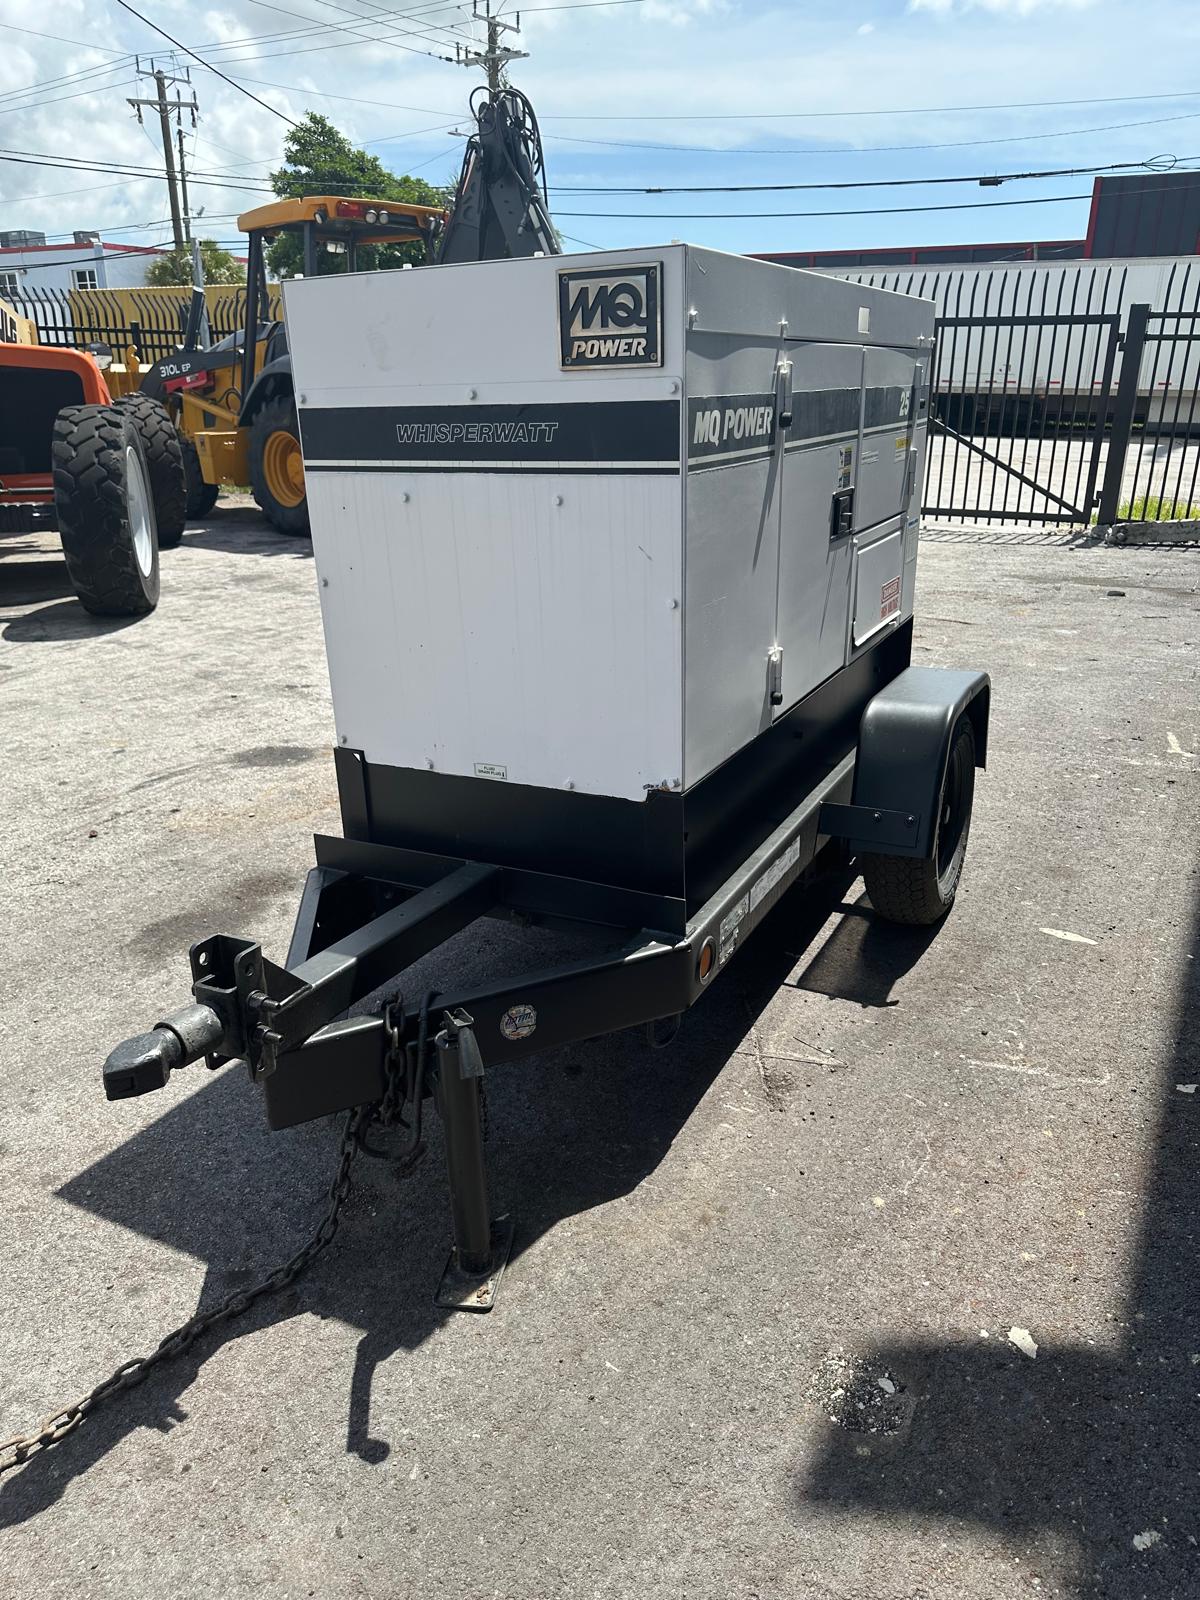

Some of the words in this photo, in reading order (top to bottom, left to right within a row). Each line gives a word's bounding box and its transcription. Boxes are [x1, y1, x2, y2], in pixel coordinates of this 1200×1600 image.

[569, 282, 646, 330] MQ
[571, 338, 647, 359] POWER
[160, 364, 180, 378] 310L
[181, 363, 191, 373] EP
[899, 390, 910, 416] 25
[396, 422, 559, 443] WHISPERWATT
[693, 409, 721, 447] MQ
[723, 406, 774, 440] POWER
